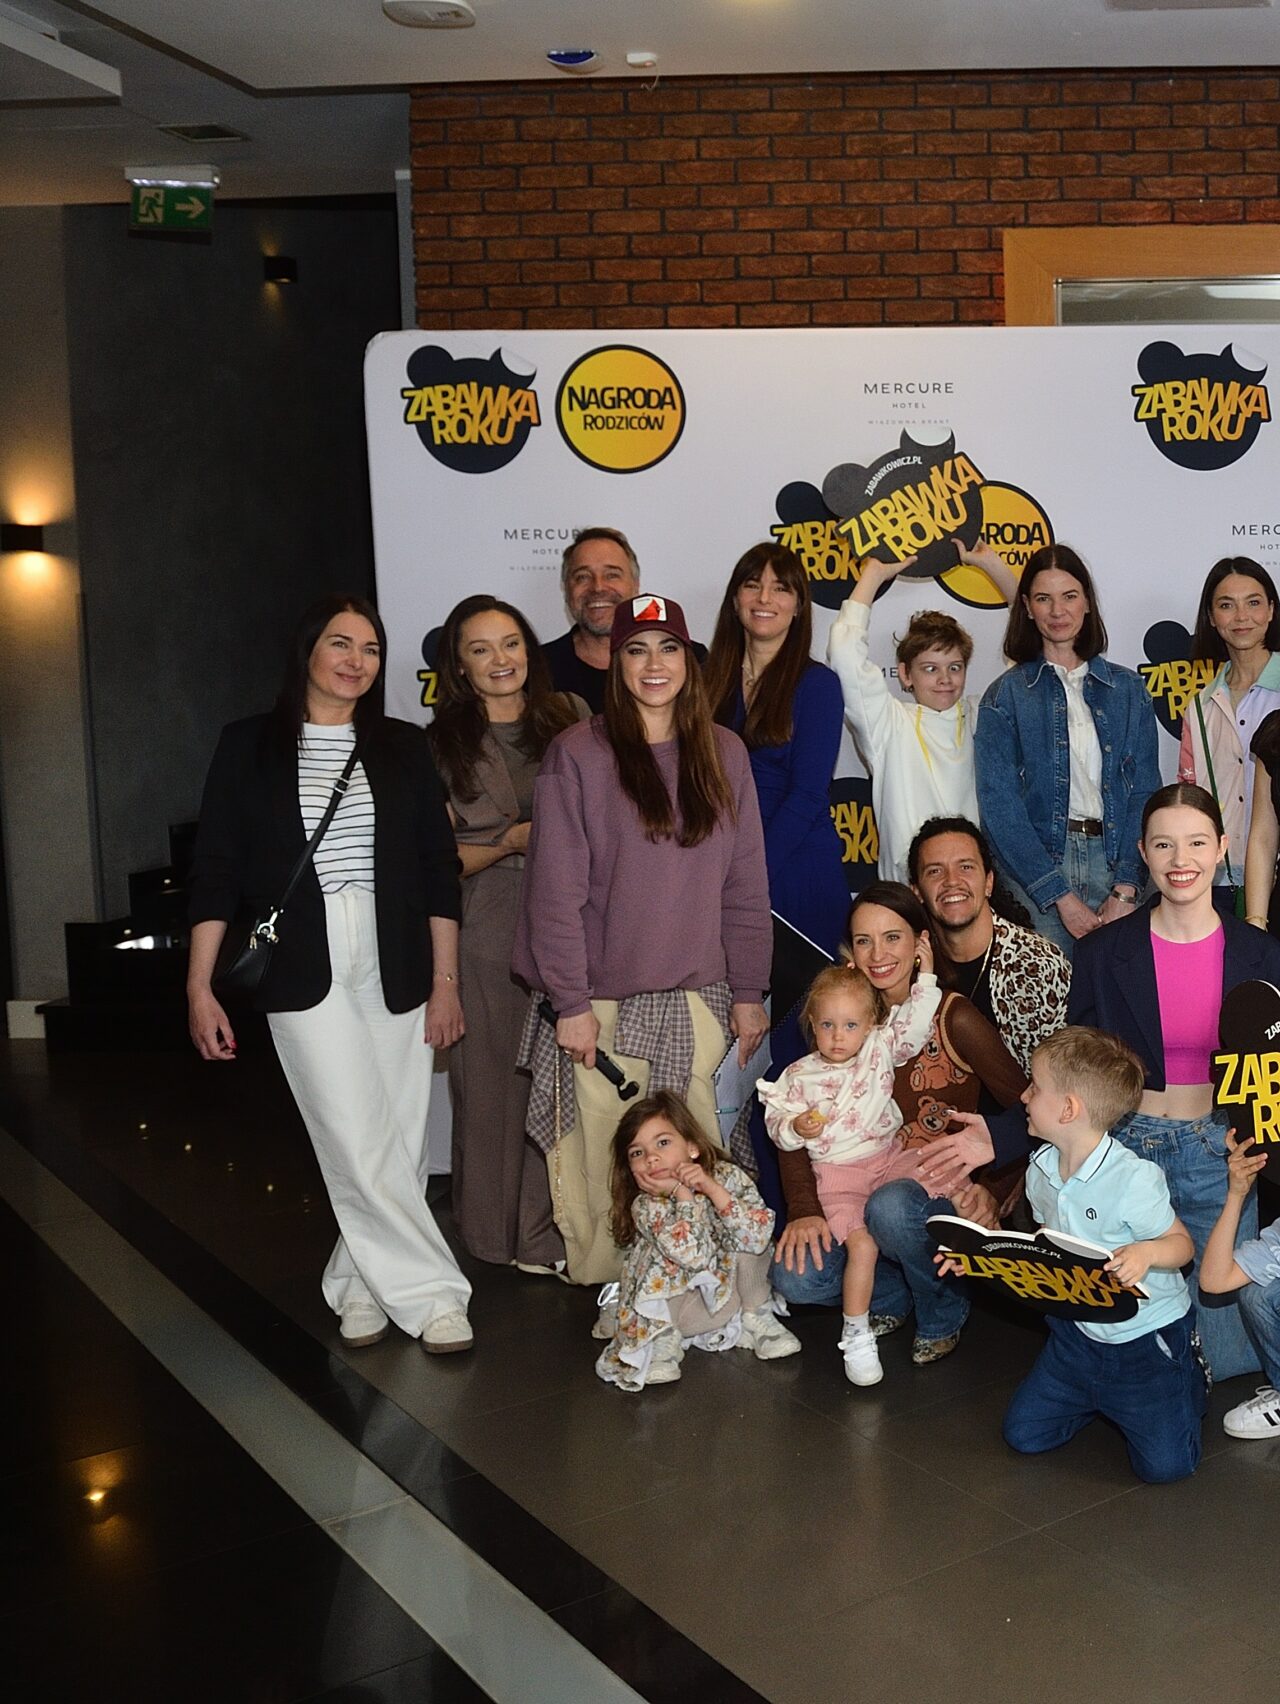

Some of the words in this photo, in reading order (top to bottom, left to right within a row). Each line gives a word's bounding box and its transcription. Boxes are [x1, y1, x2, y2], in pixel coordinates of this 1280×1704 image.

[402, 381, 539, 424] ZABAWKA
[568, 385, 677, 411] NAGRODA
[863, 382, 954, 394] MERCURE
[1133, 377, 1269, 420] ZABAWKA
[431, 413, 517, 446] ROKU
[583, 412, 665, 431] RODZICÓW
[1161, 409, 1246, 442] ROKU
[864, 456, 923, 497] ZABAWKOWICZ.PL
[838, 455, 984, 557] ZABAWKA
[503, 528, 580, 540] MERCUR
[772, 520, 850, 553] ZABA
[883, 492, 968, 562] ROKU
[980, 522, 1046, 546] RODA
[800, 550, 866, 582] ROK
[1140, 659, 1226, 698] ZABA
[1000, 1276, 1115, 1308] ROKU
